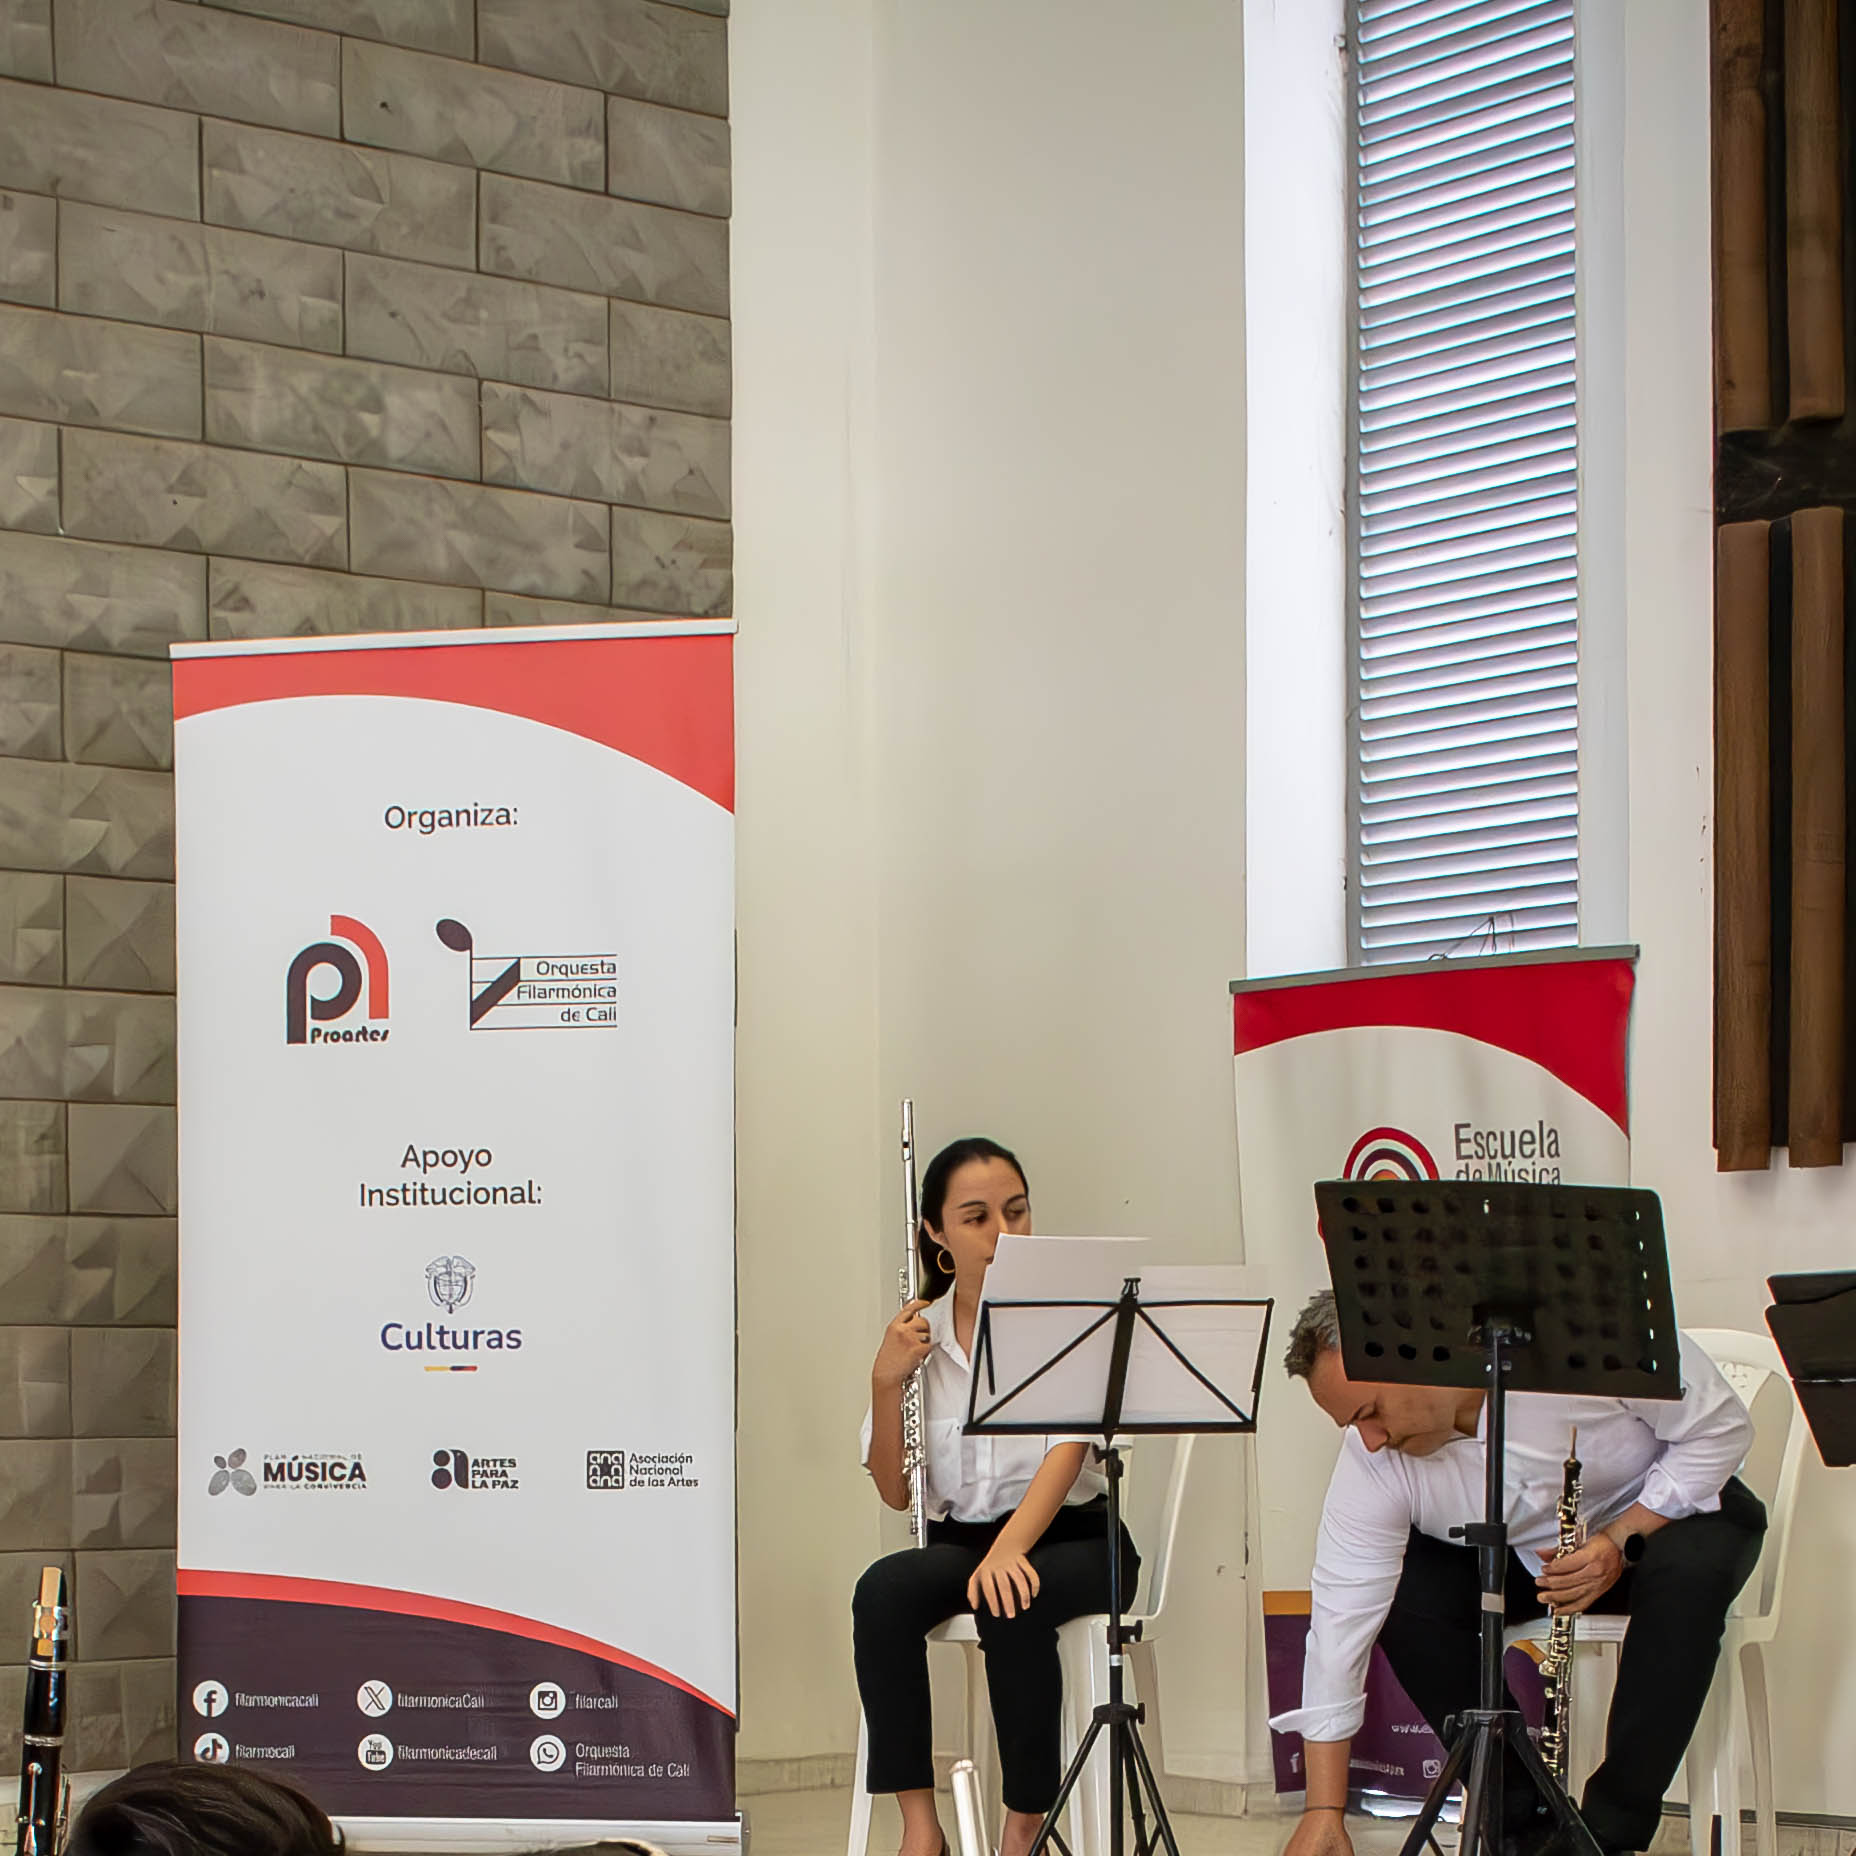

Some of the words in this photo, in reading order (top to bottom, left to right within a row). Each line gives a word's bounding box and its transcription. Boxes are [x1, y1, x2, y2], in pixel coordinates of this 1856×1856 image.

[384, 802, 518, 835] Organiza:
[536, 960, 616, 978] Orquesta
[517, 984, 616, 1000] Filarmónica
[560, 1007, 580, 1022] de
[586, 1006, 616, 1022] Cali
[311, 1026, 389, 1044] Proartes
[1454, 1120, 1560, 1160] Escuela
[400, 1144, 492, 1174] Apoyo
[360, 1179, 542, 1206] Institucional:
[380, 1322, 522, 1350] Culturas
[471, 1458, 516, 1468] ARTES
[629, 1453, 693, 1464] Asociación
[263, 1455, 367, 1481] MÚSICA
[471, 1469, 508, 1478] PARA
[629, 1464, 683, 1475] Nacional
[471, 1480, 489, 1489] LA
[492, 1480, 519, 1489] PAZ
[629, 1477, 644, 1487] de
[648, 1477, 665, 1487] las
[668, 1477, 699, 1487] Artes
[575, 1743, 630, 1760] Orquesta
[575, 1761, 644, 1777] Filarmónica
[648, 1763, 663, 1777] de
[667, 1762, 690, 1777] Cali
